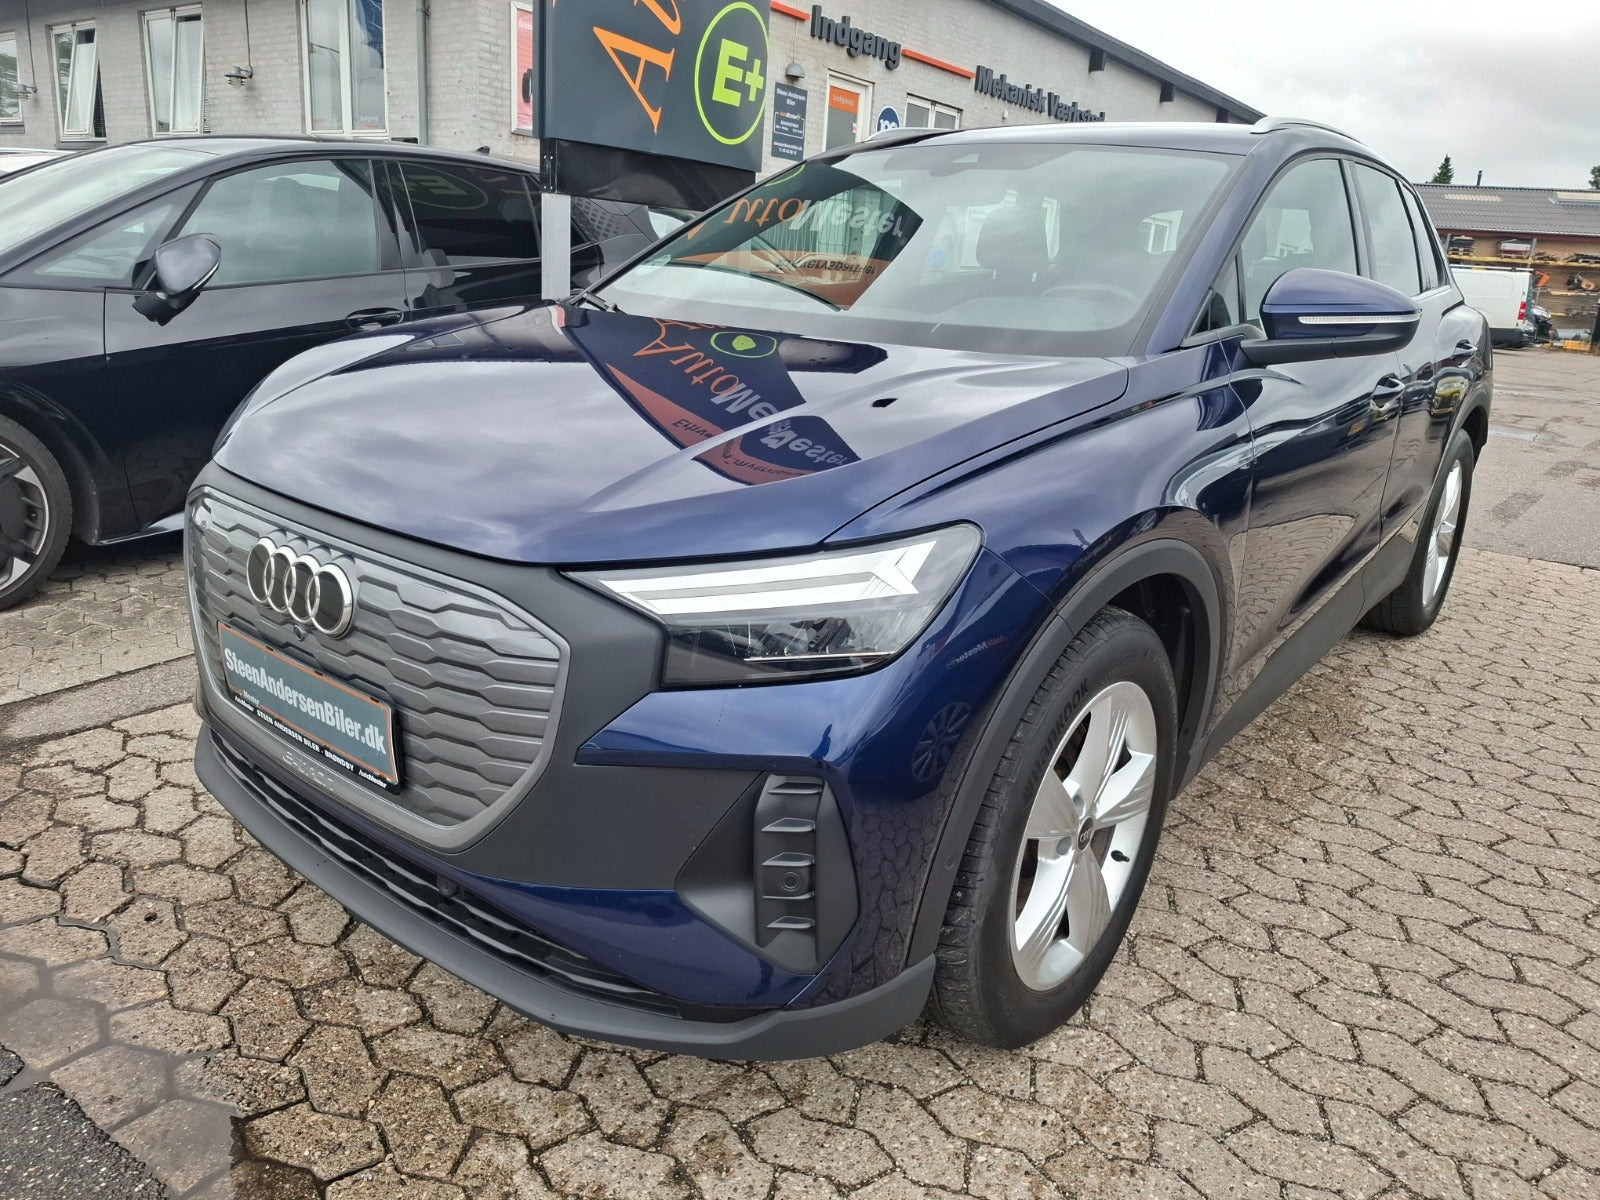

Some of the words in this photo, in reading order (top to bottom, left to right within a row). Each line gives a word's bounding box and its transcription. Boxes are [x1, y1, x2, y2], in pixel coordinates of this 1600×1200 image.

[810, 4, 902, 71] Indgang
[974, 65, 1047, 113] Mekanisk
[224, 648, 387, 755] SteenAndersenBiler.dk
[273, 720, 303, 743] ANDERSEN
[303, 737, 320, 753] BILER
